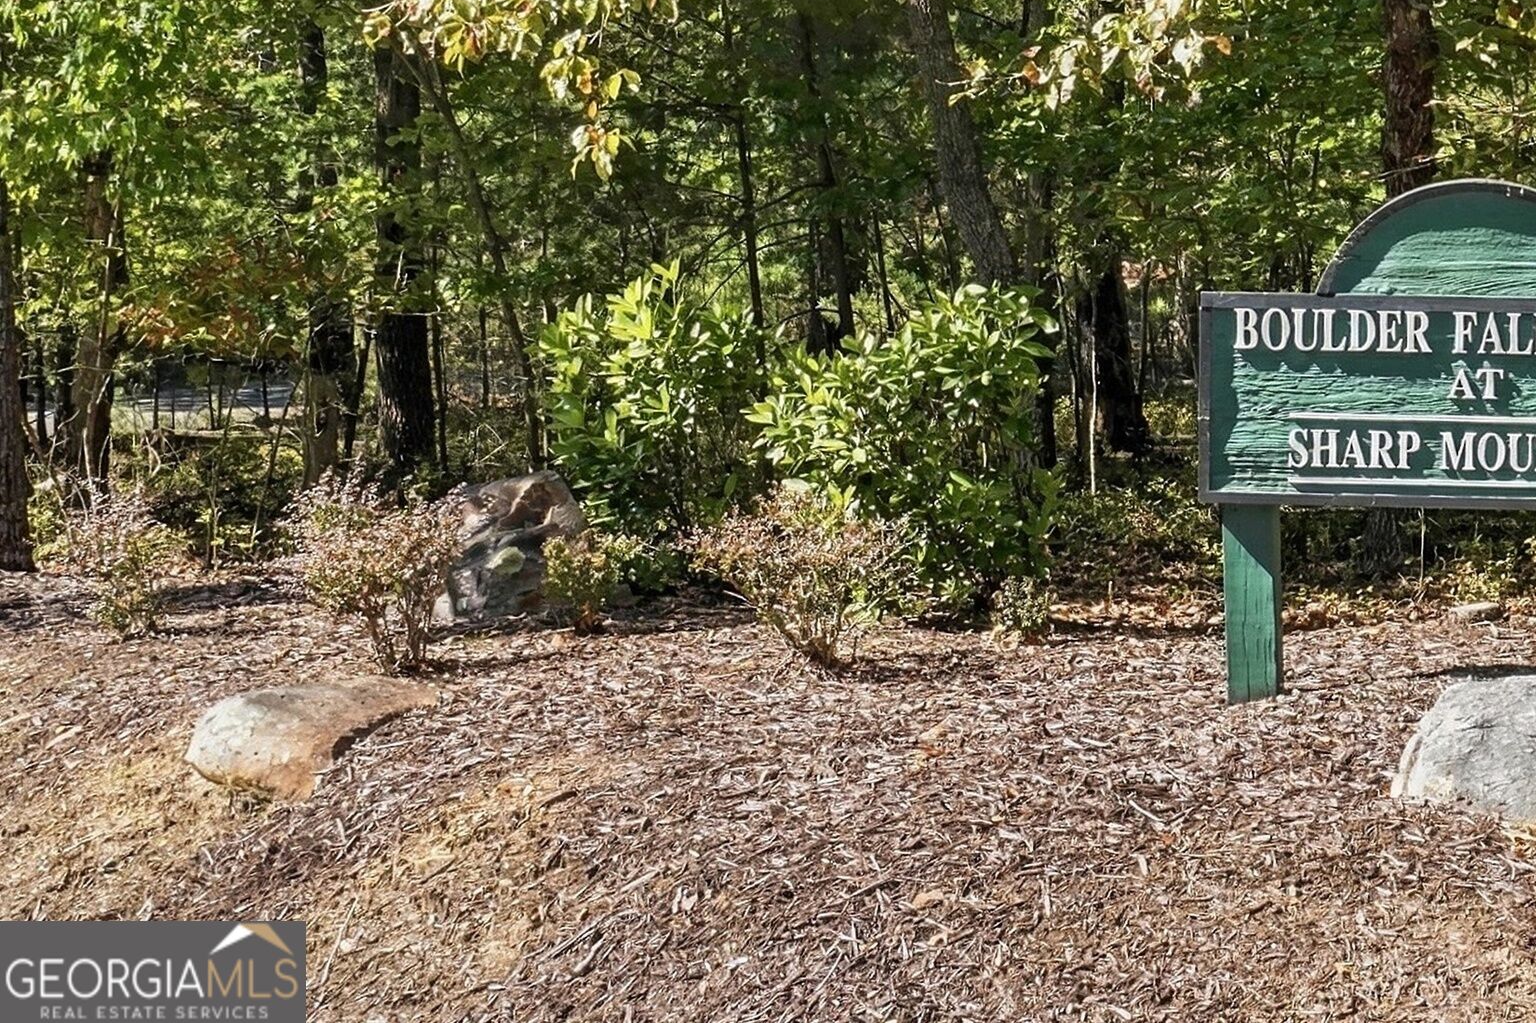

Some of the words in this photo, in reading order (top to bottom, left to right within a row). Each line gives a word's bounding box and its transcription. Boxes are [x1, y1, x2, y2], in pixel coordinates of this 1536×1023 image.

[1233, 307, 1431, 353] BOULDER
[1448, 367, 1504, 400] AT
[1288, 428, 1421, 469] SHARP
